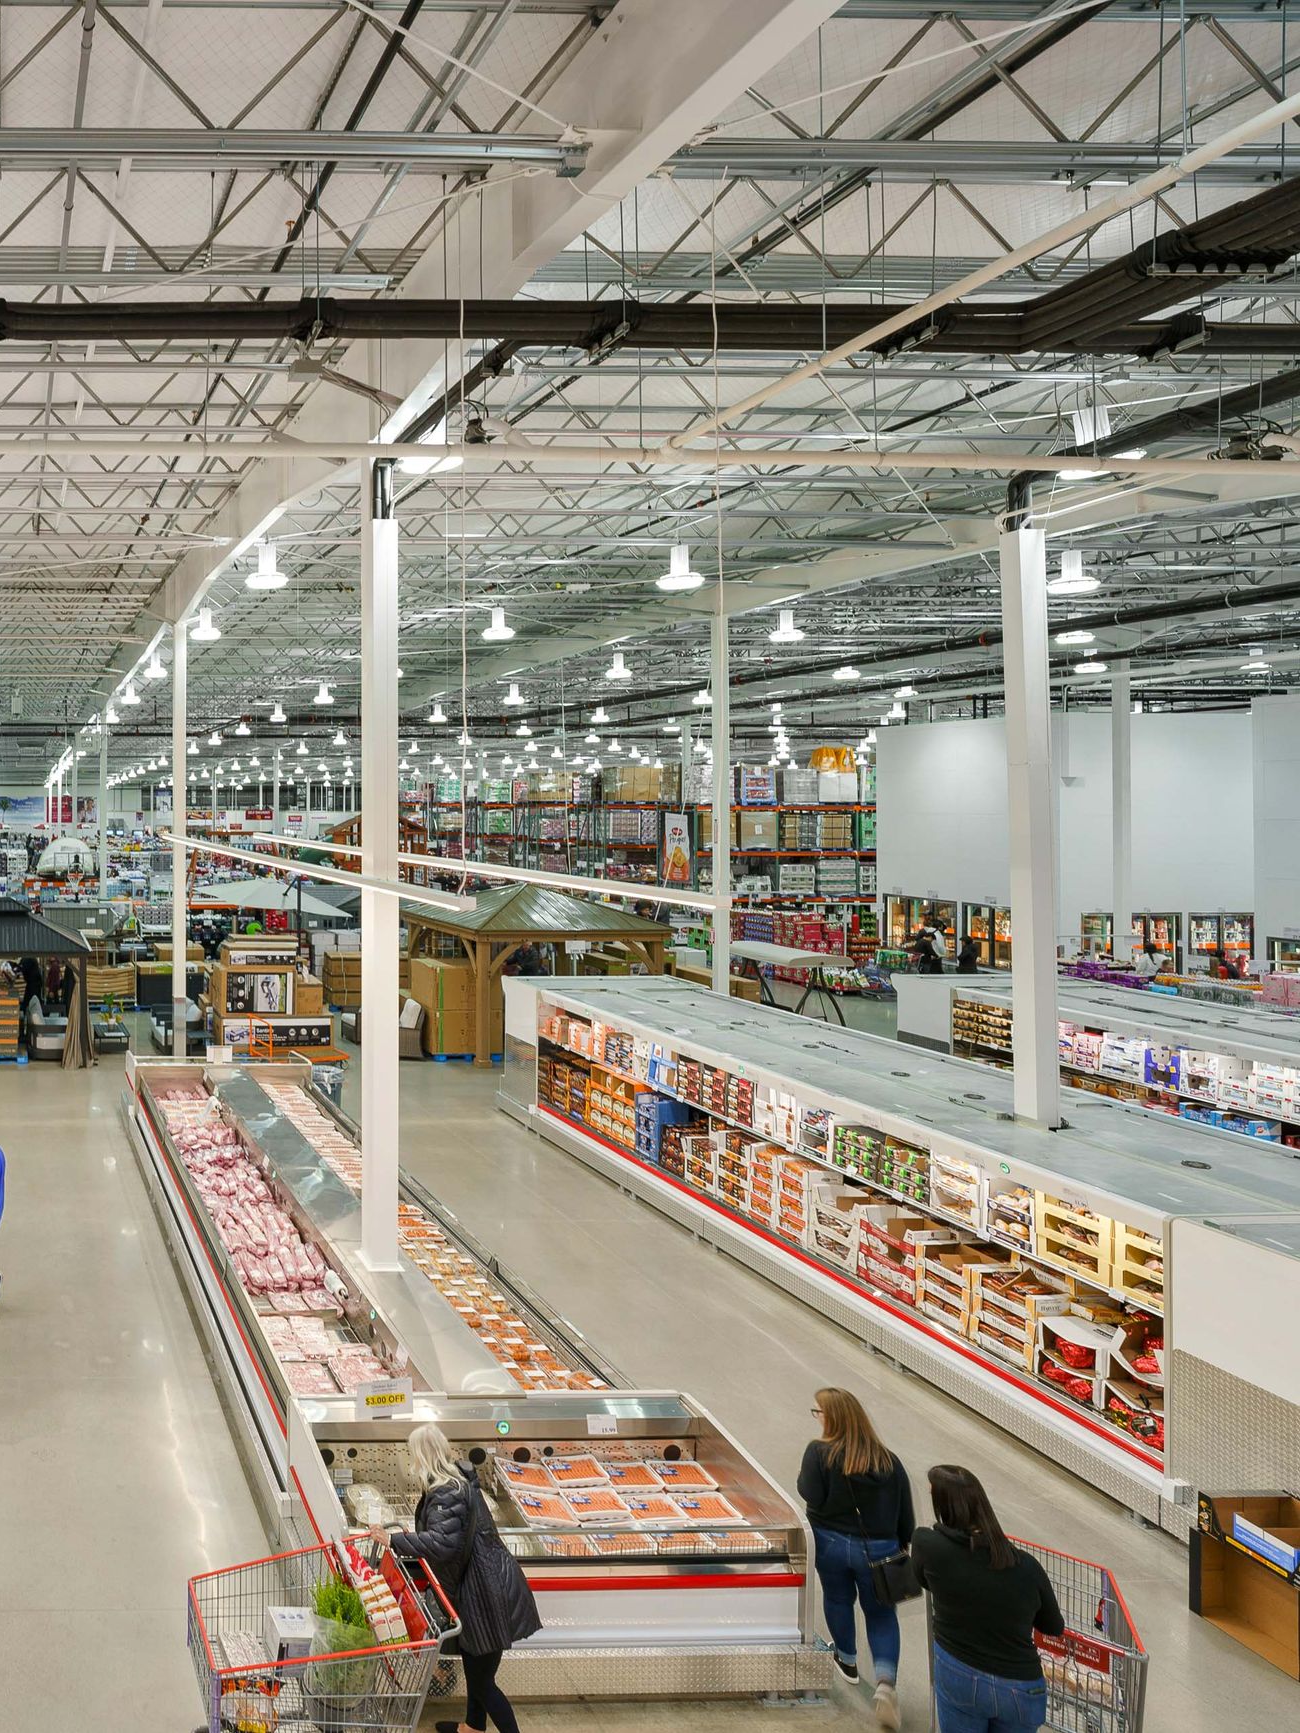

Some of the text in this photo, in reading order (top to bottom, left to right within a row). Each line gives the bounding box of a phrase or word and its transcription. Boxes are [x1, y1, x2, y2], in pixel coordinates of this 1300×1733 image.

[365, 1393, 405, 1406] $3.00 OFF
[1042, 1637, 1065, 1649] COSTCO
